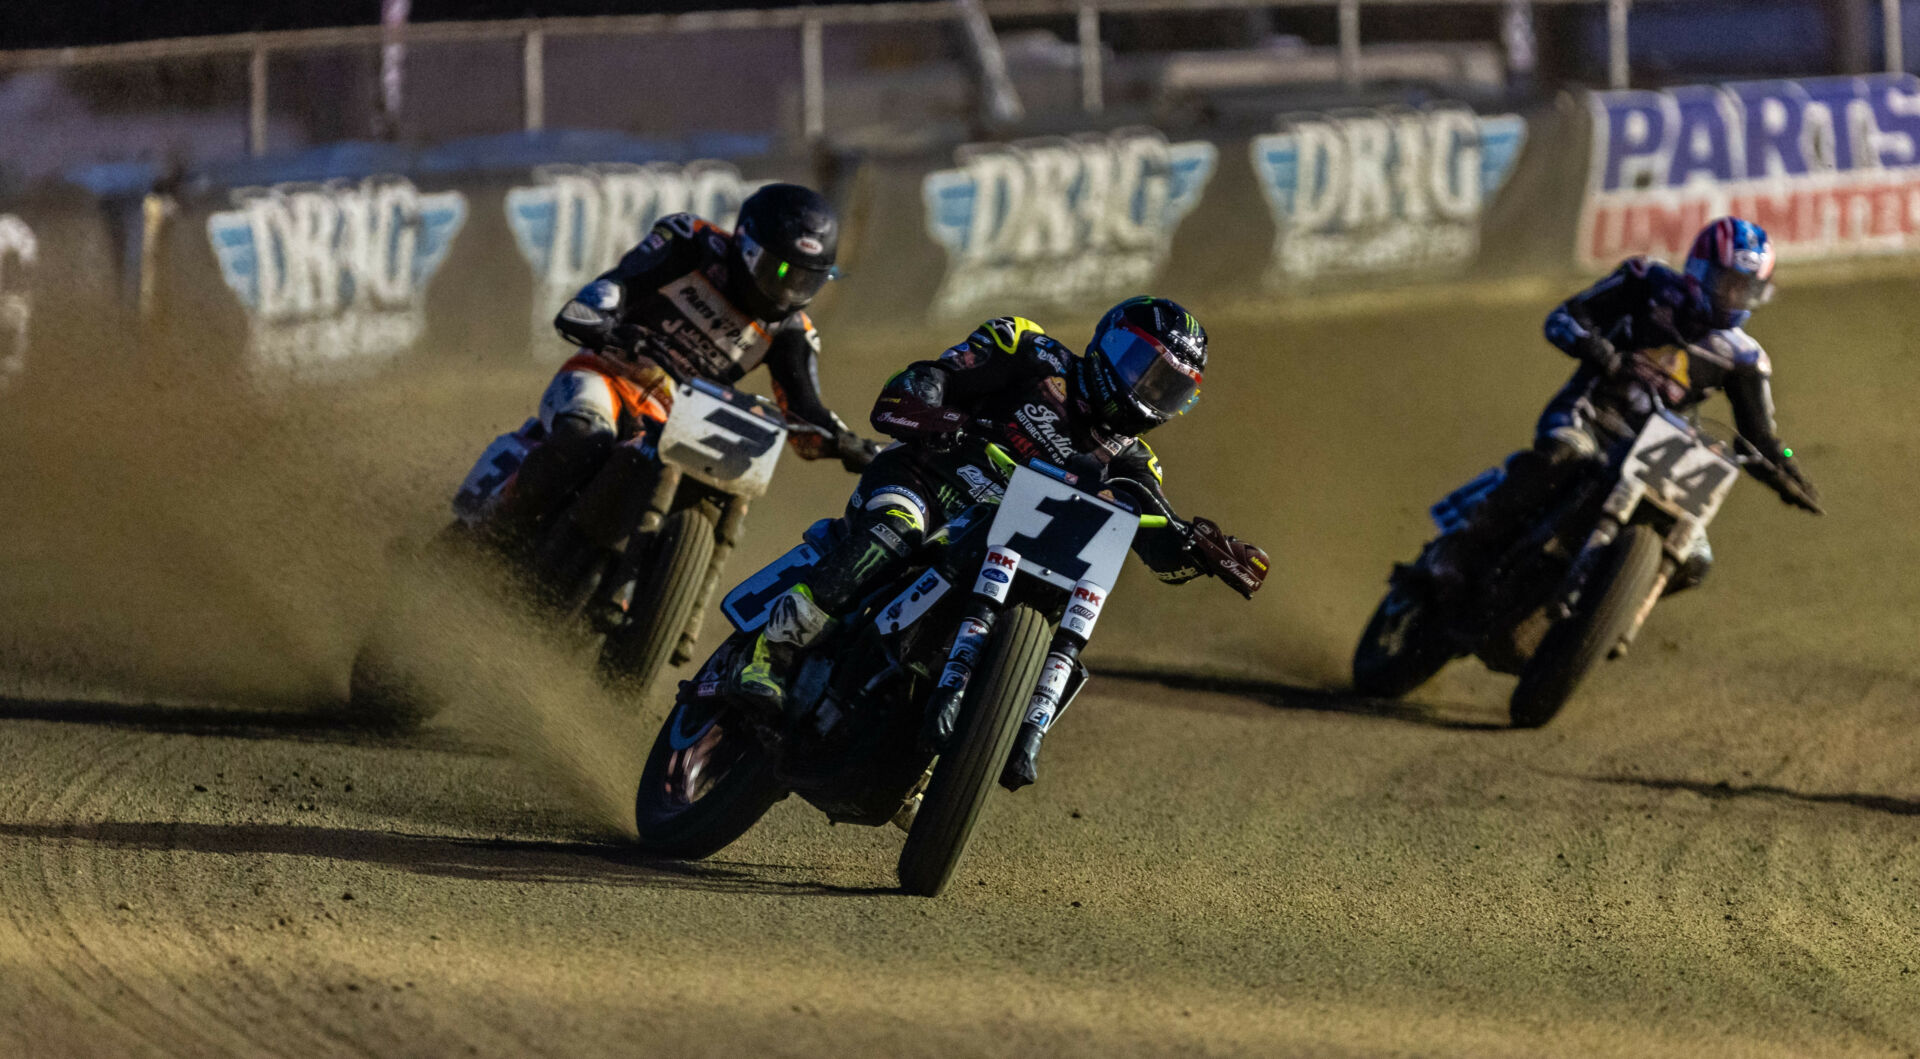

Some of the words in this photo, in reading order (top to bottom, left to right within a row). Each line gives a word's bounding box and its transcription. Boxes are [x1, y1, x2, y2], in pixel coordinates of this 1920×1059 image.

[1602, 82, 1920, 192] PARTS
[1592, 182, 1920, 257] UNIMITE
[665, 408, 780, 481] 3
[876, 411, 920, 429] Indian
[1636, 439, 1731, 517] 44
[987, 551, 1015, 570] RK
[1005, 495, 1113, 582] 1
[1220, 559, 1256, 588] Indian
[1074, 586, 1101, 607] RK
